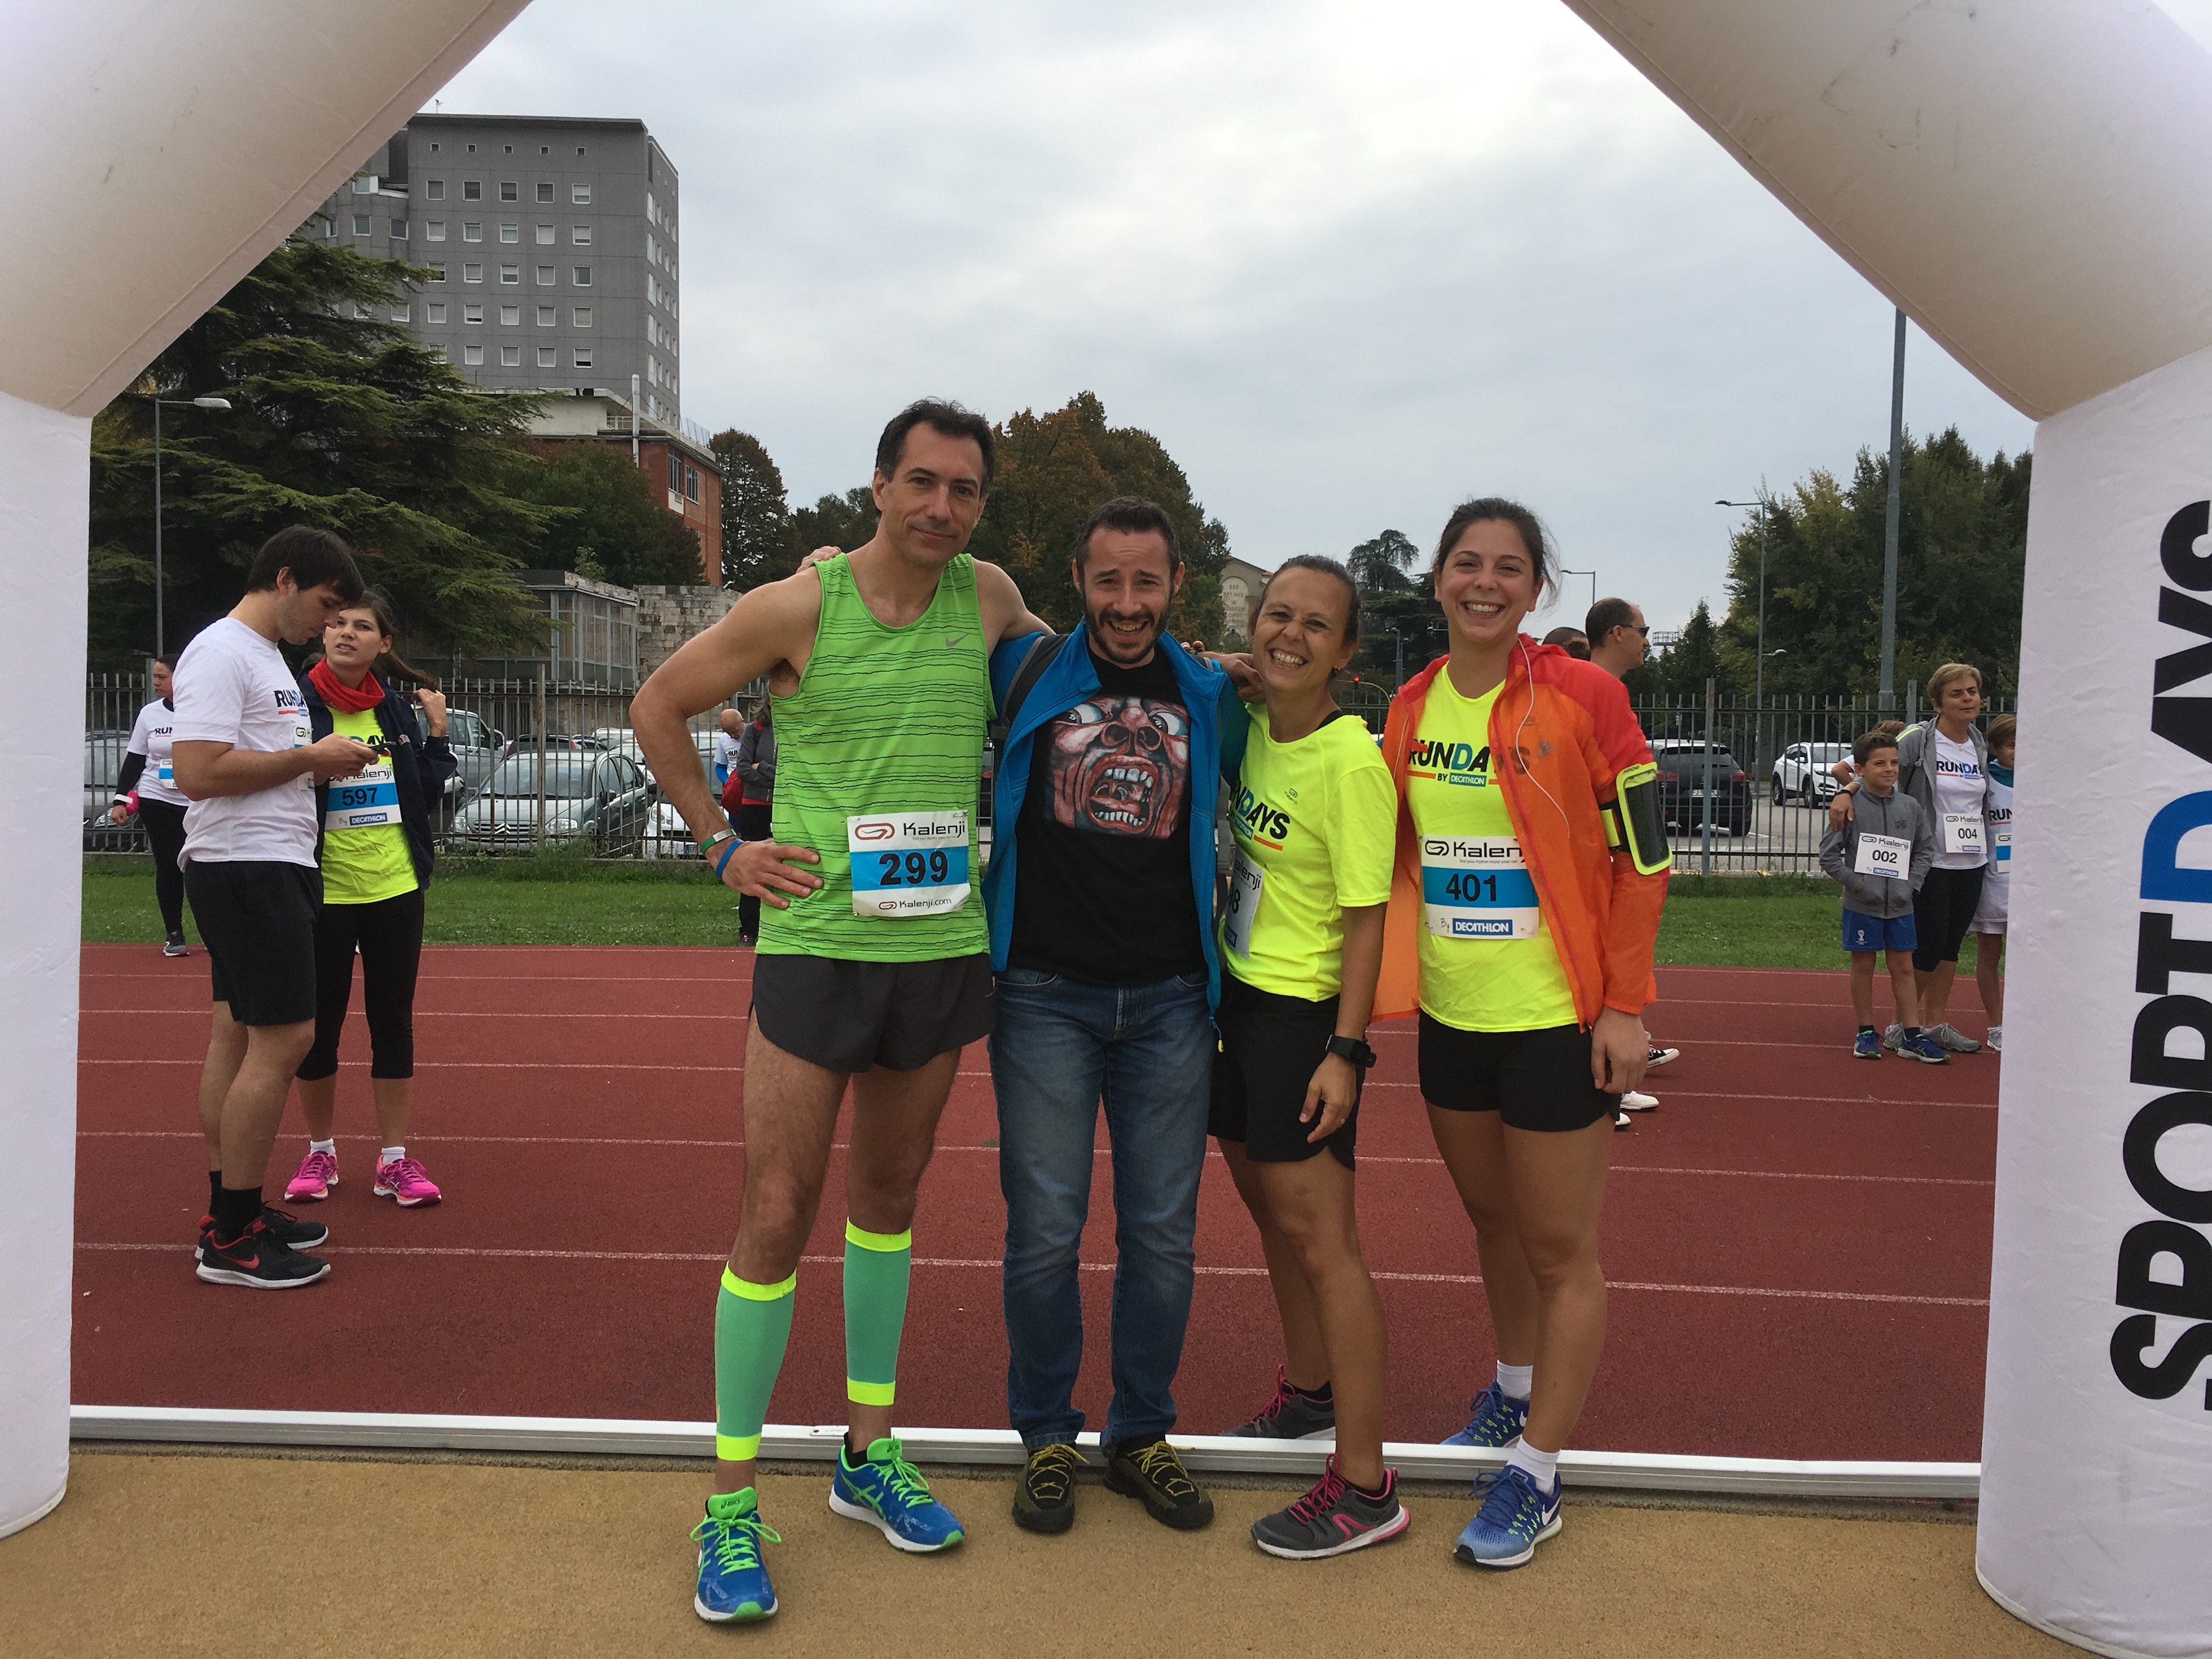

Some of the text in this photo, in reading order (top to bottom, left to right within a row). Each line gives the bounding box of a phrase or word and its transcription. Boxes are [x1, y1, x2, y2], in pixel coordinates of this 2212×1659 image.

[1451, 775, 1485, 786] DECATHLON
[341, 787, 378, 806] 597
[352, 815, 386, 825] DECATHLON
[903, 821, 966, 838] Kalenji
[1958, 828, 1978, 839] 004
[1878, 838, 1909, 851] Kalenji
[1872, 849, 1898, 864] 002
[879, 851, 948, 886] 299
[1445, 874, 1497, 902] 401
[899, 897, 952, 909] Kalenji.com
[1455, 921, 1510, 933] DECATHLON
